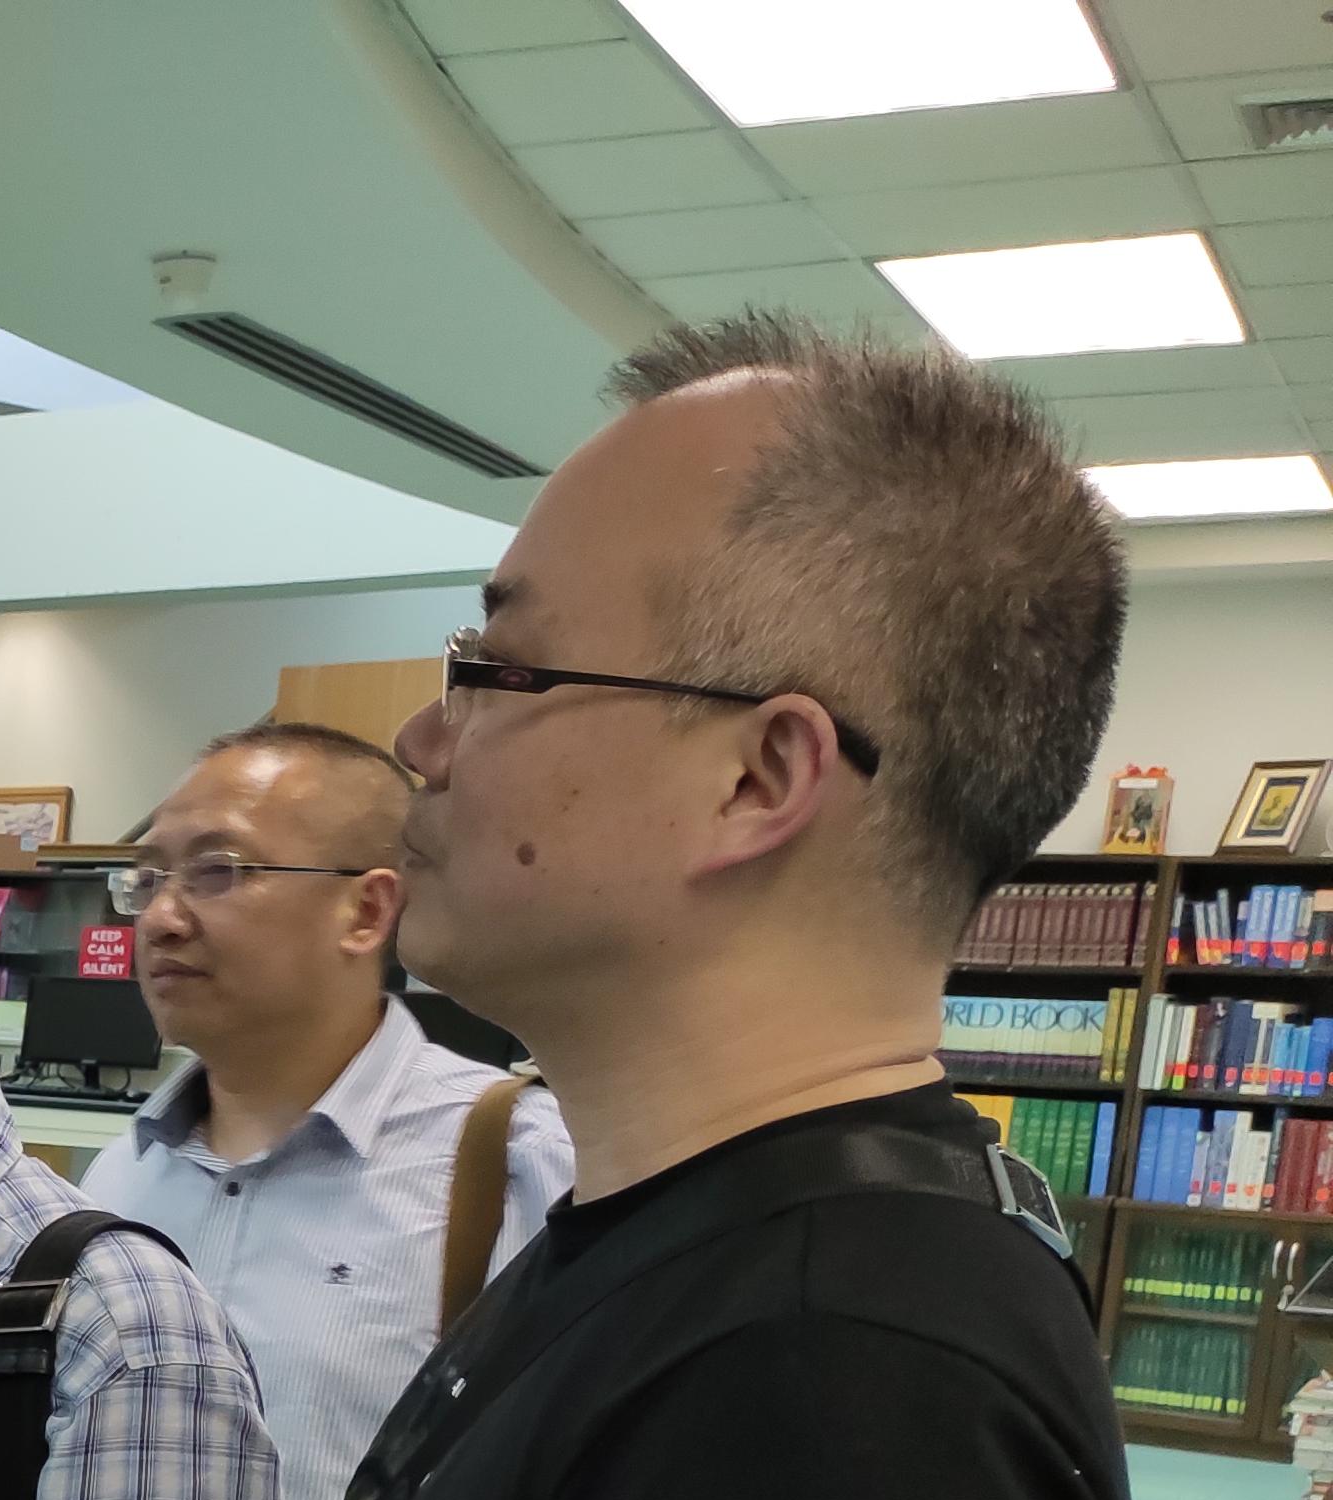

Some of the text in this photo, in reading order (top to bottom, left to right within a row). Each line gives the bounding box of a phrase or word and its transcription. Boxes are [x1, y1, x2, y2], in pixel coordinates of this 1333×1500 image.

[91, 930, 123, 942] KEEP
[86, 943, 125, 956] CALM
[83, 962, 125, 975] SILENT
[942, 1002, 1004, 1028] RLD
